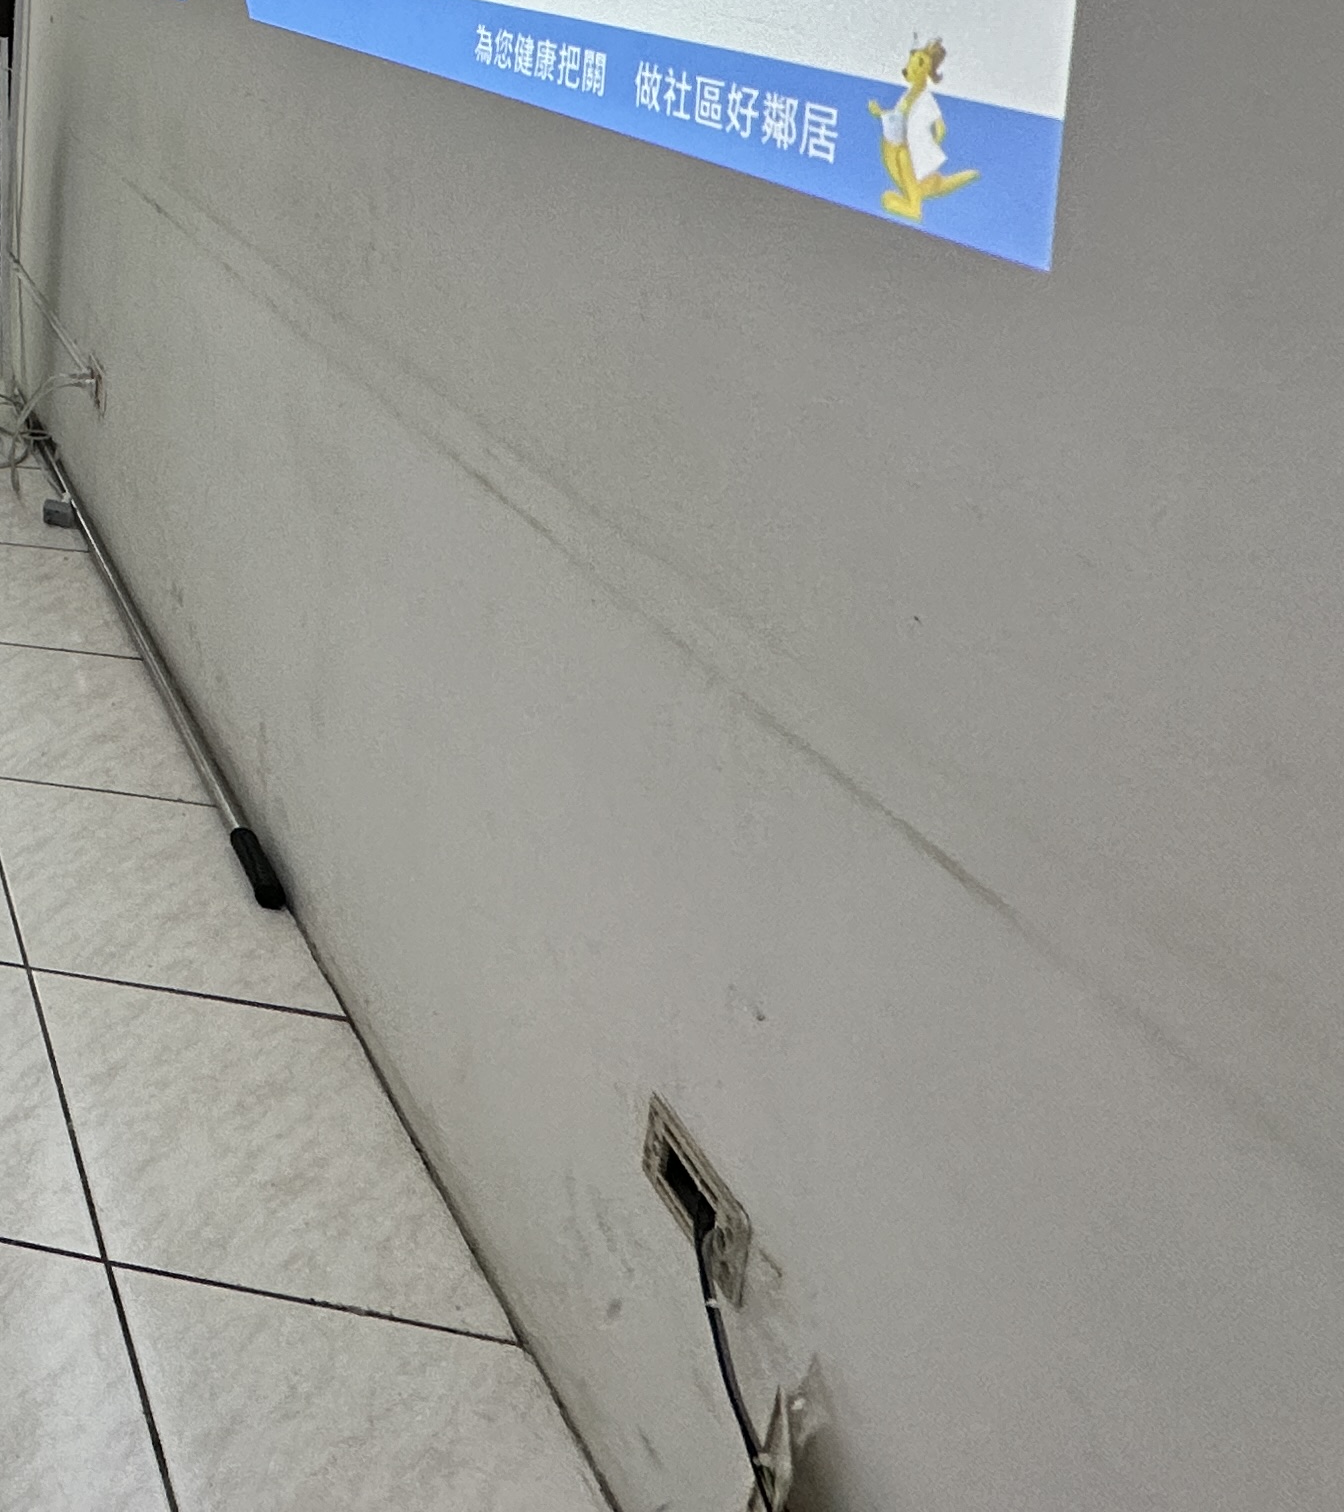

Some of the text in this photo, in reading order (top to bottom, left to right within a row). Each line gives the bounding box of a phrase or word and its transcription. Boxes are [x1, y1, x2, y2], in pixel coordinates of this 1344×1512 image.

[474, 25, 838, 164] 為您健康把關 做社區好鄰居
